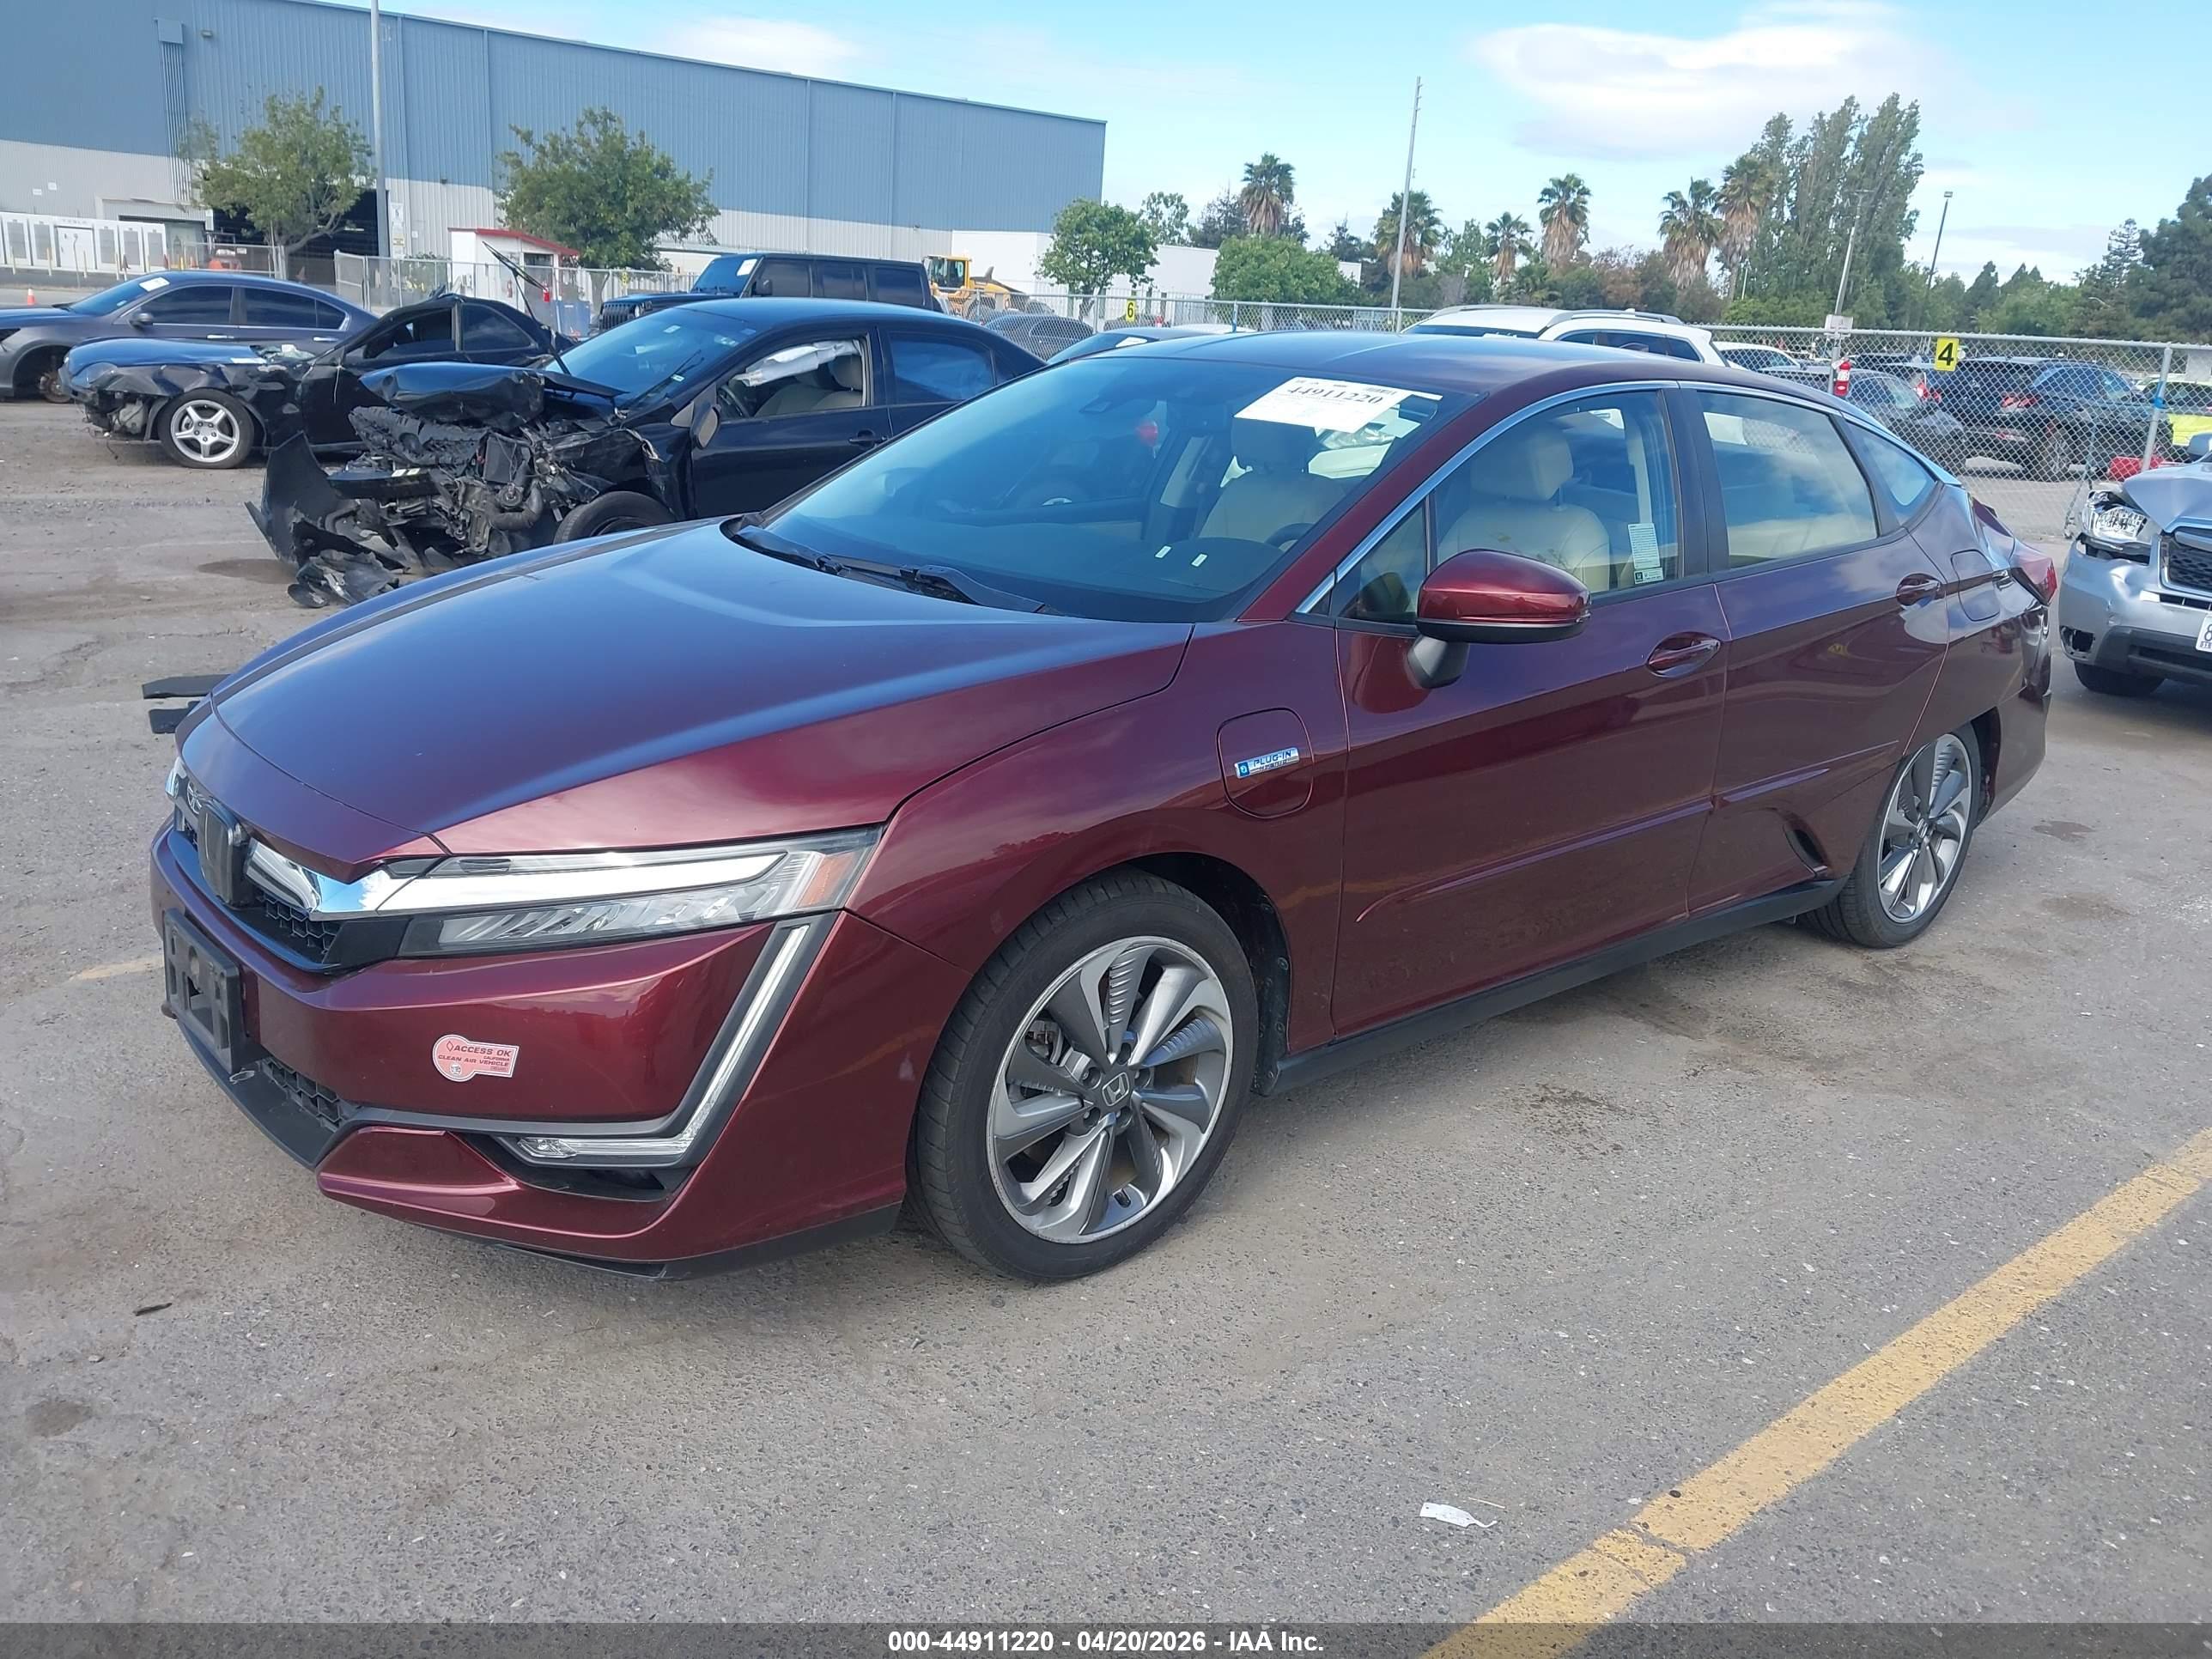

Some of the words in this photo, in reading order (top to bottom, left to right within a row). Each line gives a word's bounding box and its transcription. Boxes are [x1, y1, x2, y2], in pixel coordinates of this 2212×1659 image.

[1127, 301, 1134, 318] 6
[1937, 342, 1954, 367] 4
[1287, 386, 1384, 404] 44911220
[1253, 750, 1292, 768] PLUG-IN
[453, 1044, 494, 1056] ACCESS
[496, 1048, 513, 1057] OK
[479, 1059, 510, 1067] VEHICLE
